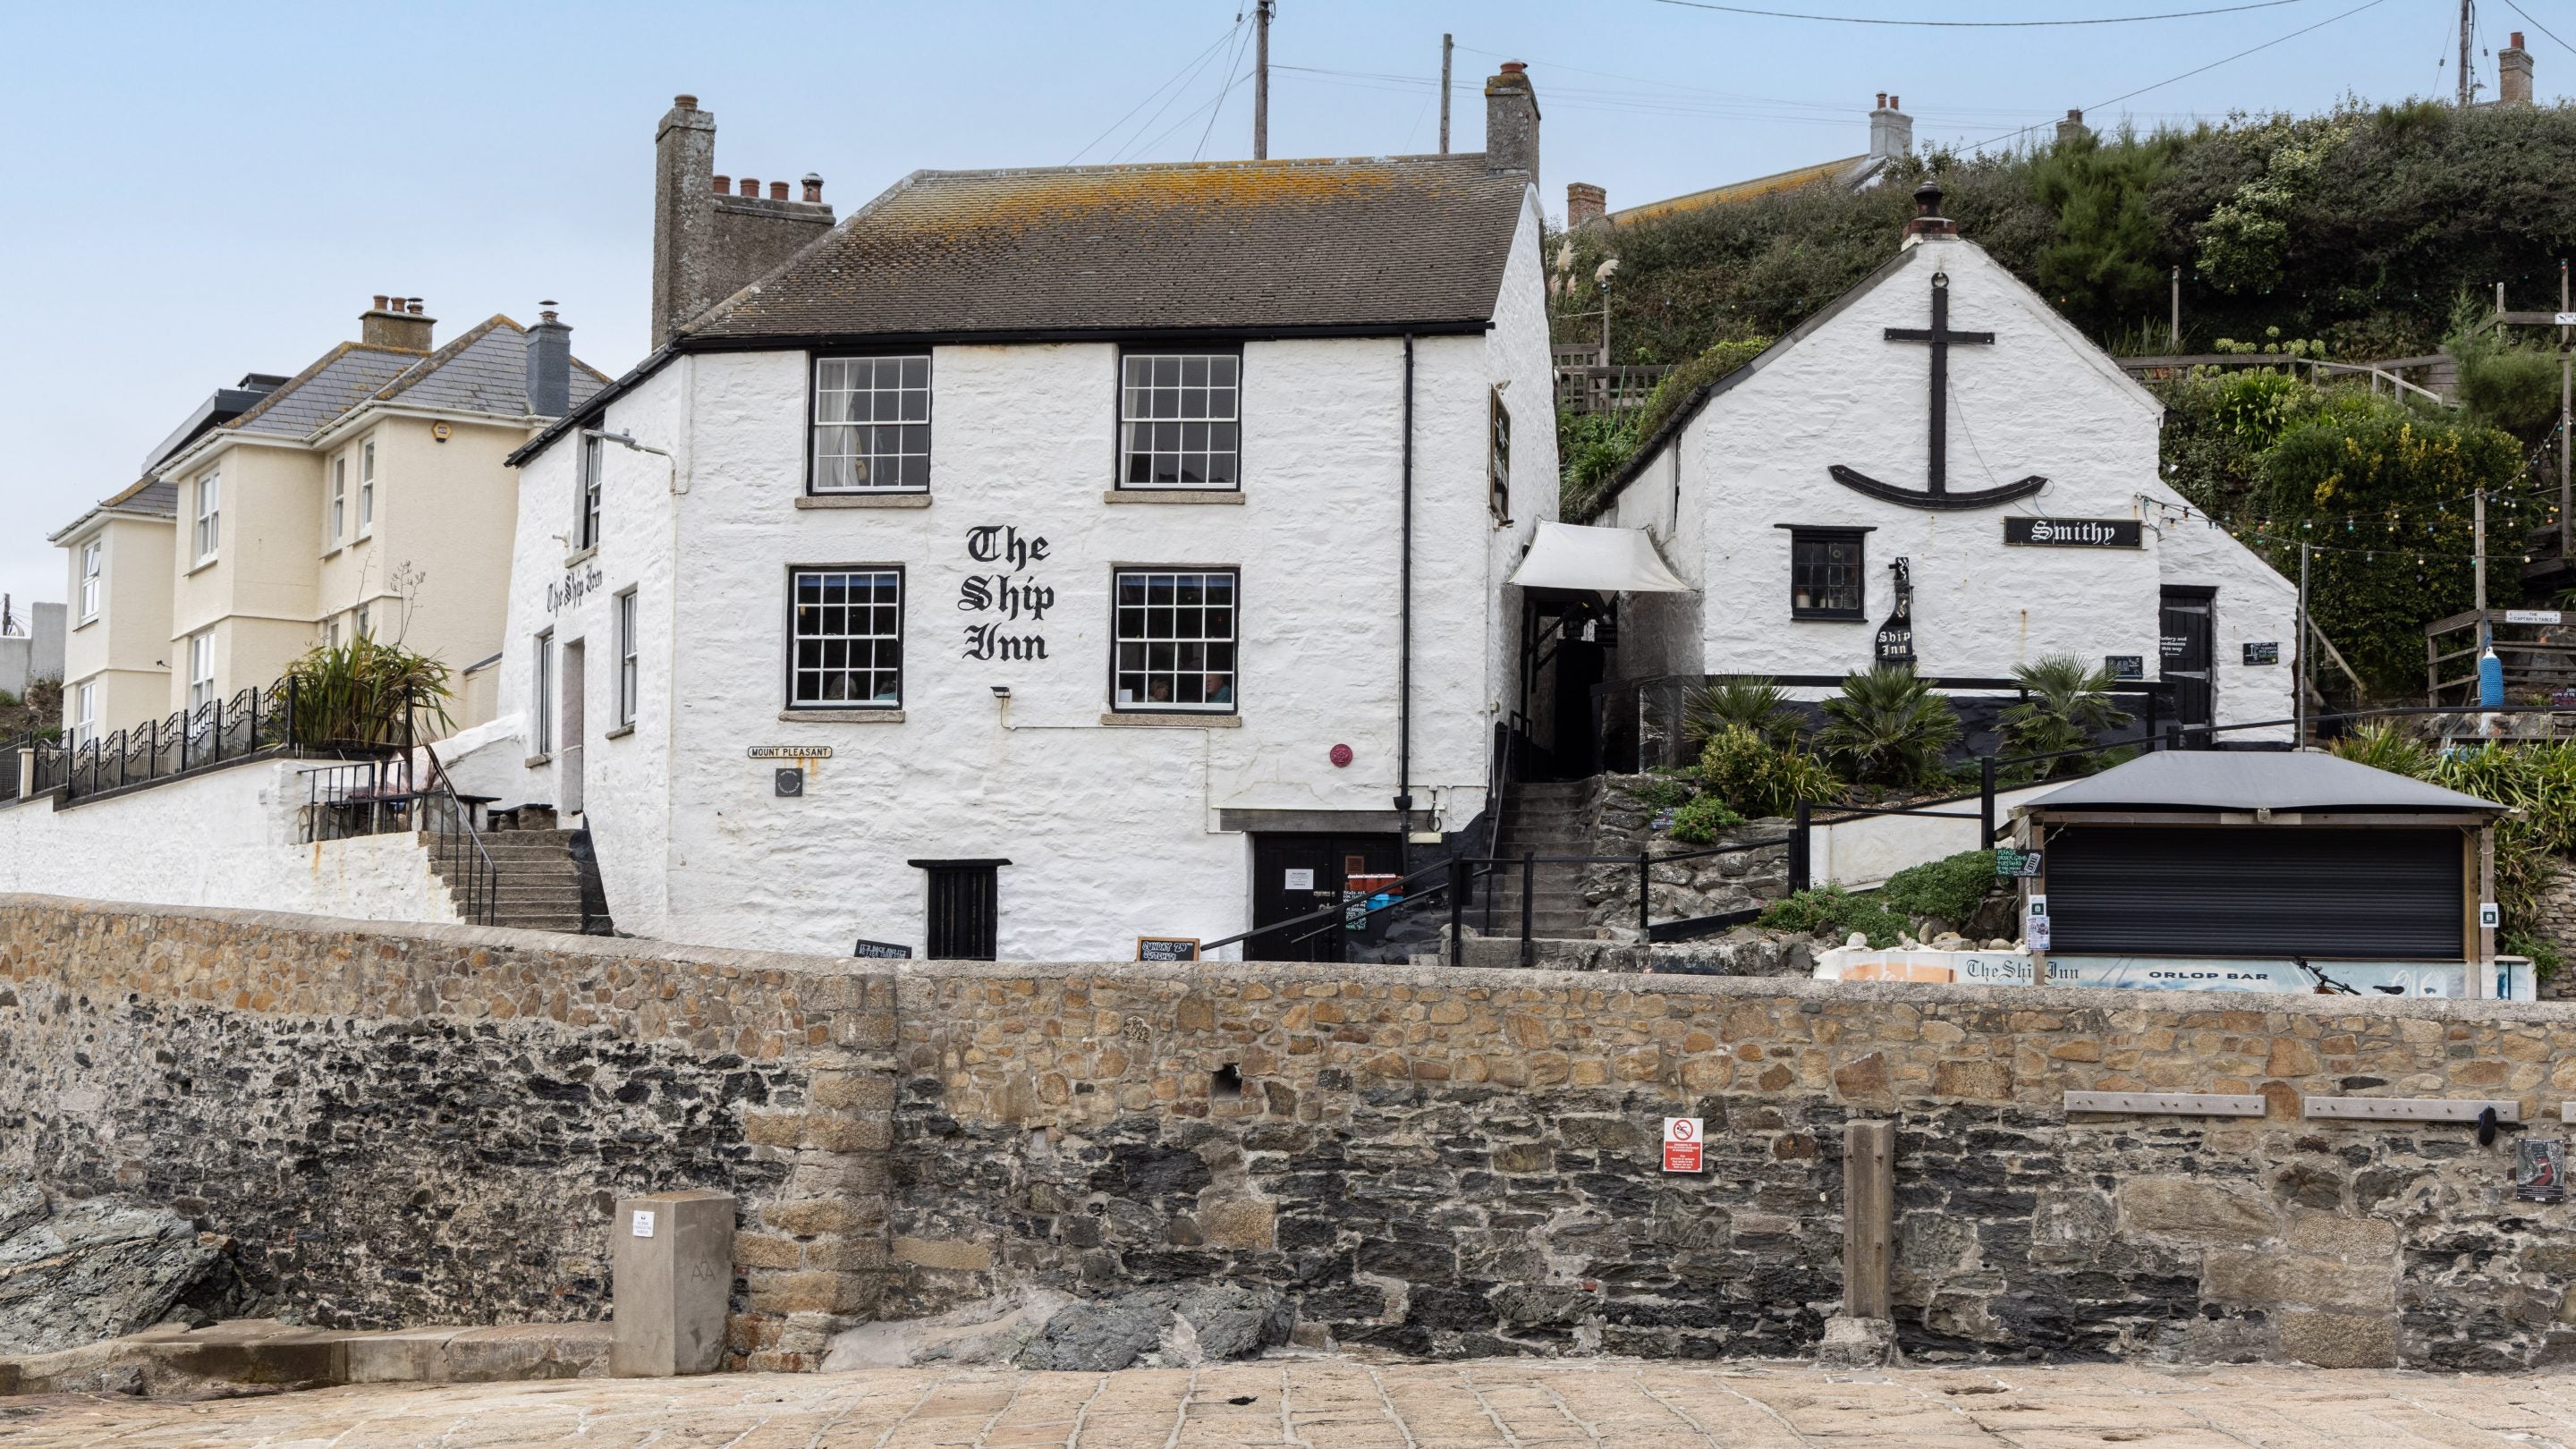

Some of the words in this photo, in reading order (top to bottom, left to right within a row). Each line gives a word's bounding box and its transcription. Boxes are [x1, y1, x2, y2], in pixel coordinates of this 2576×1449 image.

[2031, 520, 2115, 545] Smithy
[966, 524, 1051, 572] The
[547, 580, 563, 617] The
[564, 570, 584, 610] Ship
[586, 564, 602, 593] Inn
[957, 575, 1055, 621] Ship
[962, 623, 1049, 662] Inn
[1878, 631, 1911, 643] Ship
[1882, 645, 1906, 656] Inn
[751, 748, 780, 757] MOUNT
[783, 748, 828, 757] PLEASANT
[1142, 942, 1173, 952] SUNDAY
[1966, 959, 1998, 982] The
[1997, 960, 2033, 983] Shi
[2044, 961, 2079, 979] Inn
[2148, 971, 2218, 979] ORLOP
